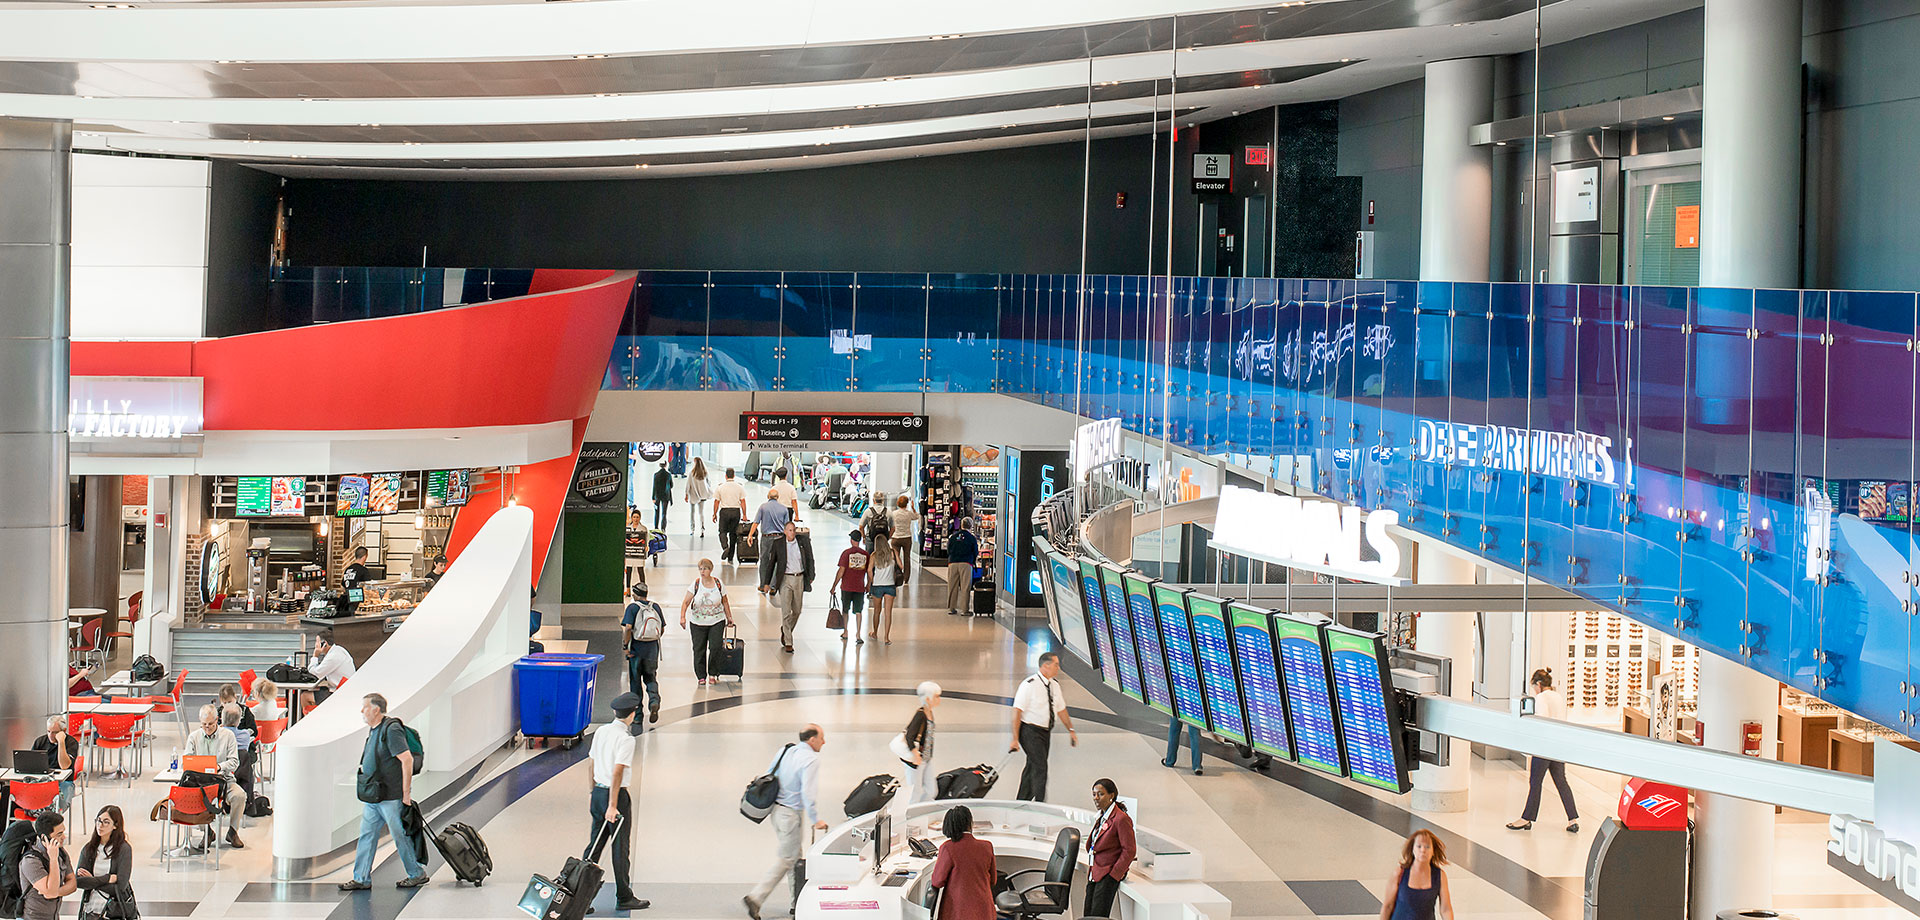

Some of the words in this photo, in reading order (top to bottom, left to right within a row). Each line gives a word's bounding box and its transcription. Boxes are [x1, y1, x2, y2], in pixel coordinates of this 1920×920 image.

[1250, 150, 1266, 162] EXIT
[1195, 181, 1226, 190] Elevator
[83, 414, 189, 438] FACTORY
[832, 418, 856, 426] Ground
[857, 418, 901, 427] Transportation
[760, 429, 786, 438] Ticketing
[832, 432, 859, 440] Baggage
[584, 467, 610, 479] PHILLY
[581, 474, 617, 489] PRETZEL
[585, 484, 617, 497] FACTORY
